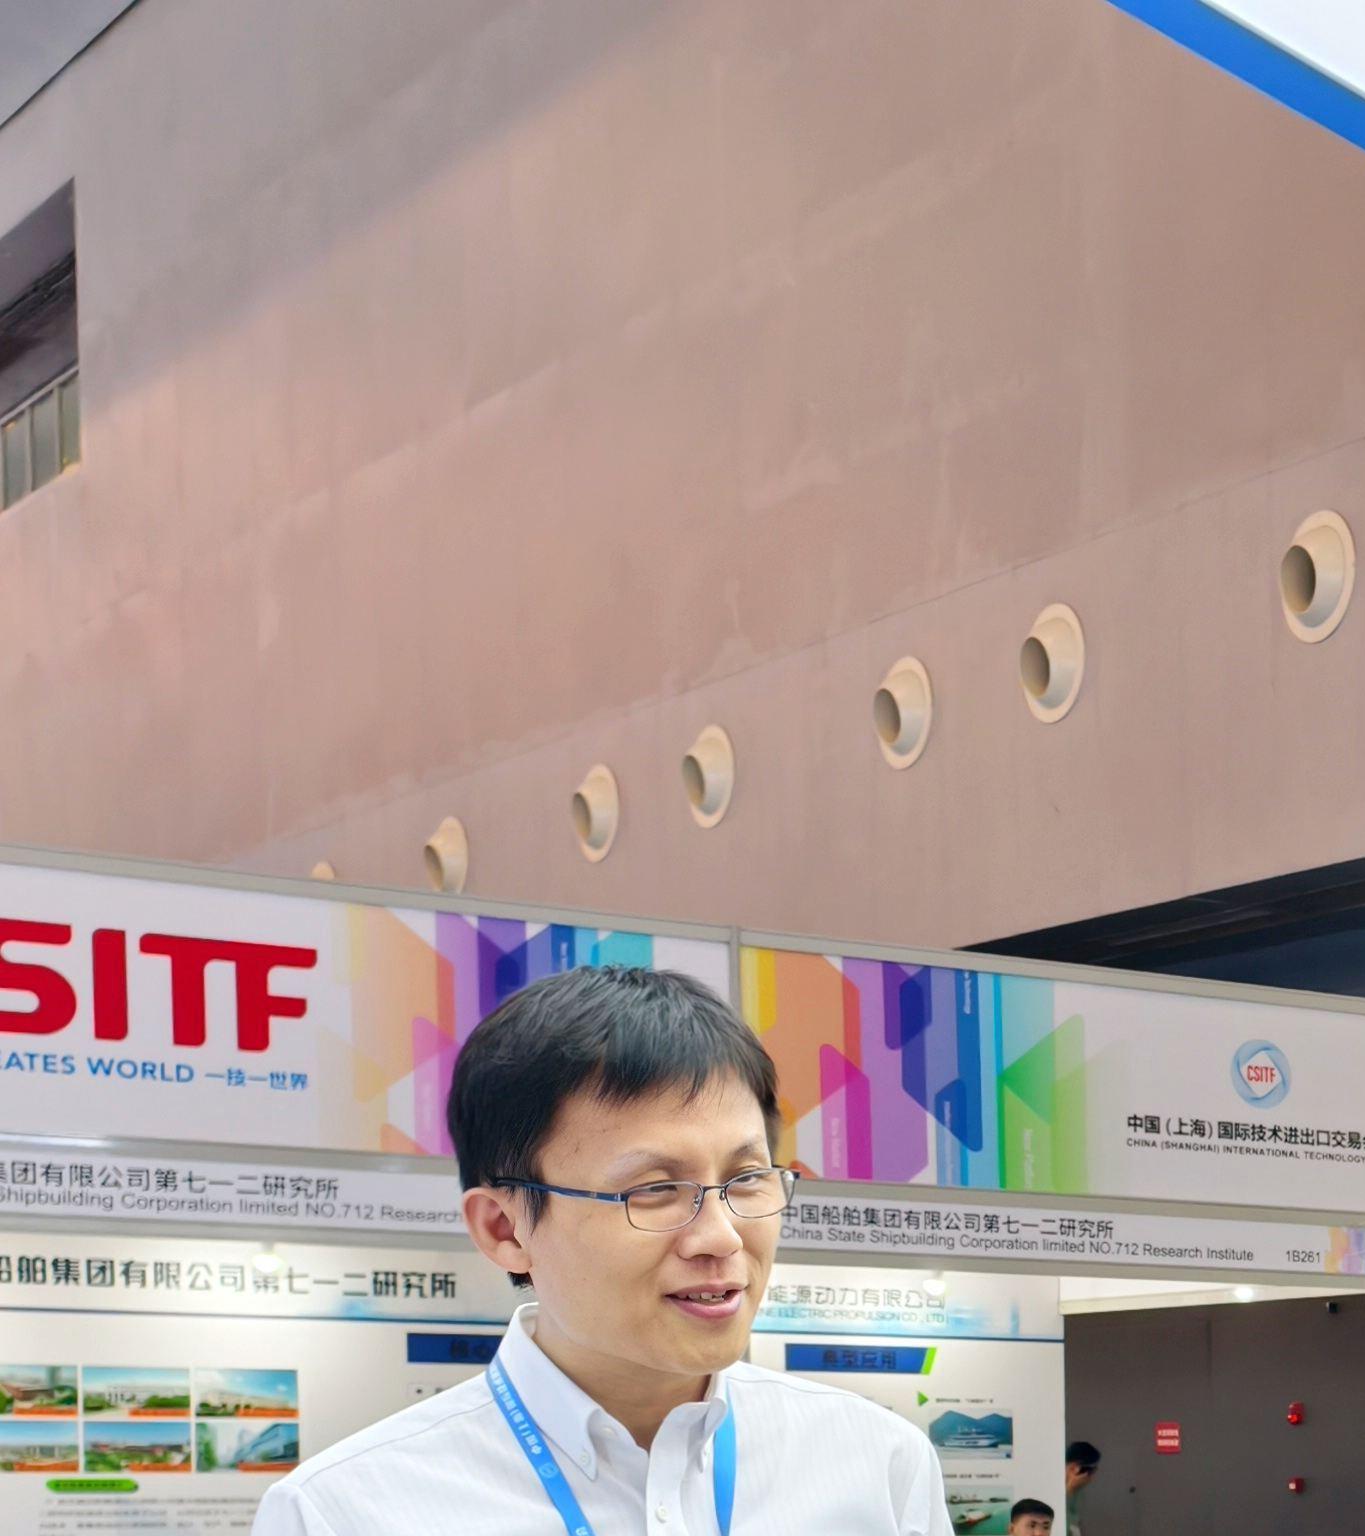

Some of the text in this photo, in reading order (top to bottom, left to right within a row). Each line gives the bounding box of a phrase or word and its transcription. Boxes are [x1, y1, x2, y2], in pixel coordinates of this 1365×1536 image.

[0, 1051, 76, 1075] ATES
[87, 1057, 195, 1083] WORLD
[1246, 1064, 1276, 1083] CSITF
[1126, 1137, 1158, 1149] CHINA
[1160, 1140, 1221, 1155] (SHANGHAI)
[1223, 1145, 1301, 1160] INTERNATIONAL
[0, 1160, 340, 1200] 团有限公司第七一二研究所
[121, 1192, 233, 1214] Corporation
[239, 1198, 299, 1218] limited
[305, 1201, 375, 1220] NO.712
[781, 1203, 1114, 1240] 中国船舶集团有限公司第七一二研究所
[780, 1225, 823, 1241] China
[826, 1230, 865, 1244] State
[869, 1231, 956, 1249] Shipbuilding
[959, 1236, 1039, 1253] Corporation
[1041, 1238, 1086, 1254] limited
[1089, 1242, 1140, 1258] NO.712
[1142, 1244, 1203, 1260] Research
[1205, 1247, 1255, 1262] Institute
